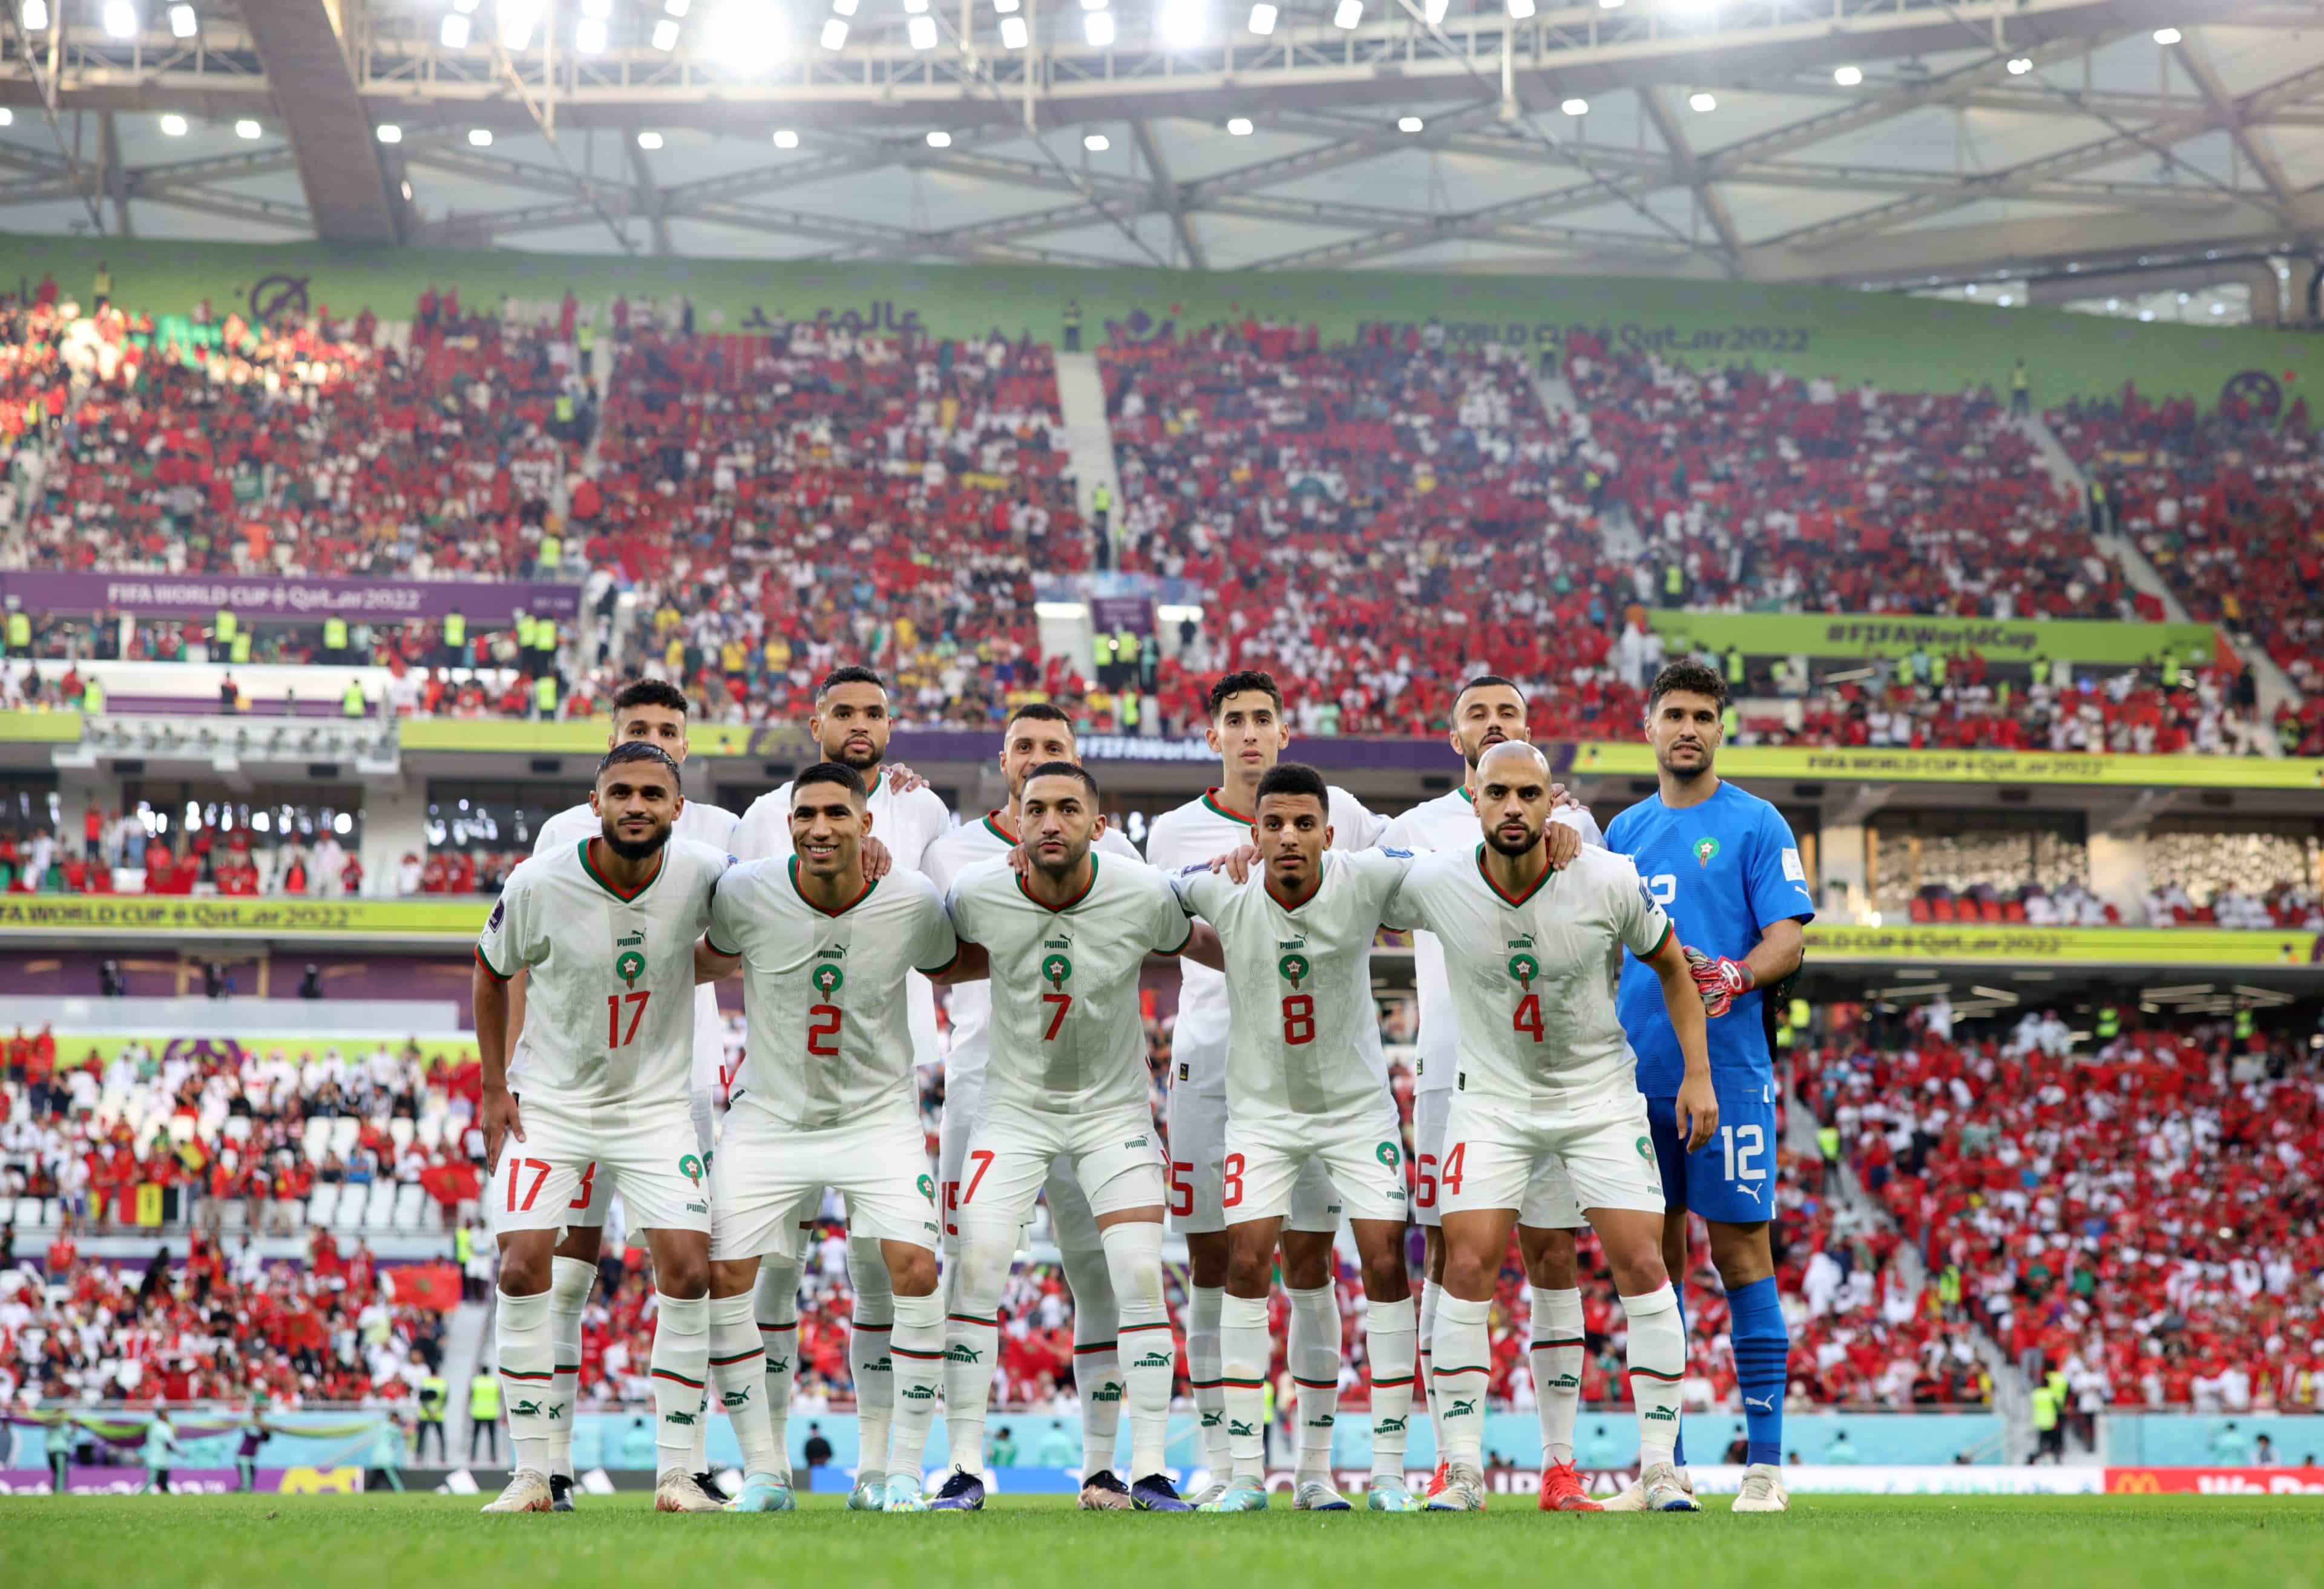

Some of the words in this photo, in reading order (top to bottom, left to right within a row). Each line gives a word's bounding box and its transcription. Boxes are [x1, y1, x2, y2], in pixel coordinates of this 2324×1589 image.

[617, 937, 642, 946] PUMA
[818, 951, 842, 959] PUMA
[1508, 940, 1532, 948] PUMA
[608, 991, 651, 1049] 17
[808, 1004, 841, 1055] 2
[1043, 994, 1072, 1040] 7
[1282, 994, 1315, 1044] 8
[1513, 994, 1544, 1042] 4
[1124, 1139, 1147, 1150] PUMA
[1722, 1124, 1767, 1181] 12
[507, 1158, 551, 1212] 17
[963, 1150, 994, 1204] 7
[1172, 1162, 1193, 1216] 5
[1223, 1153, 1244, 1208] 8
[1417, 1155, 1437, 1207] 6
[1442, 1142, 1466, 1195] 4
[686, 1203, 707, 1214] PUMA
[945, 1352, 972, 1363] UMA
[902, 1389, 933, 1400] PUMA
[1093, 1392, 1120, 1401] PUMA
[1444, 1407, 1470, 1420] PUMA
[1645, 1412, 1672, 1421] PUMA
[666, 1415, 691, 1424] PUMA
